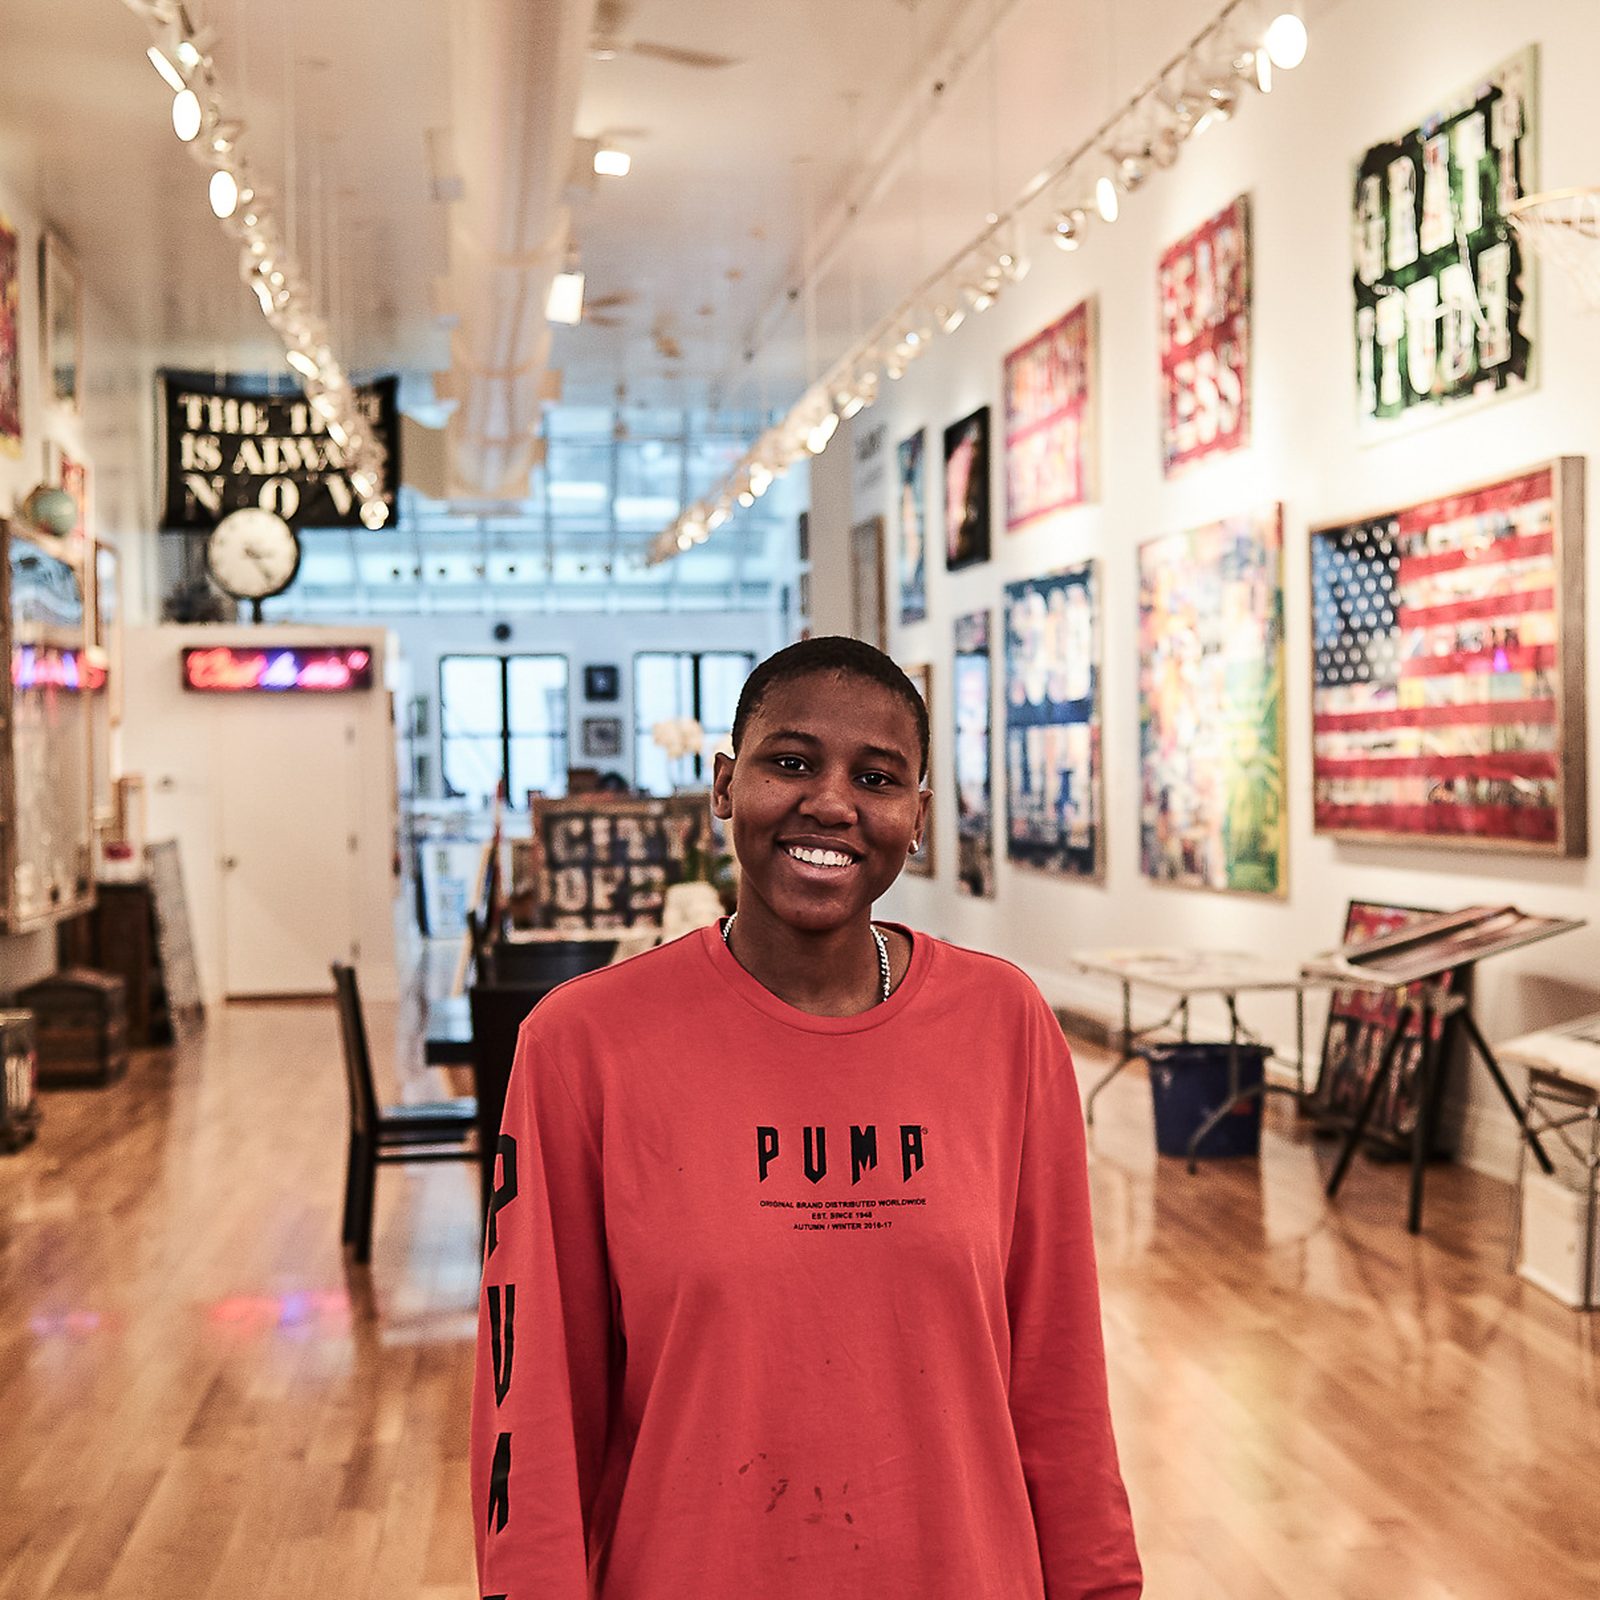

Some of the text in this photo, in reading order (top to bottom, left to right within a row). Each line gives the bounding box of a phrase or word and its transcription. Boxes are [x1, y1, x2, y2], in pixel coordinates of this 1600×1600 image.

[179, 394, 269, 435] THE
[181, 432, 223, 472] IS
[756, 1125, 924, 1186] PUMA
[759, 1198, 927, 1209] ORIGINAL BRAND DISTRIBUTED WORLDWIDE
[811, 1211, 873, 1220] EST. SINCE 1948
[793, 1223, 825, 1231] AUTUMN
[831, 1222, 862, 1230] WINTER
